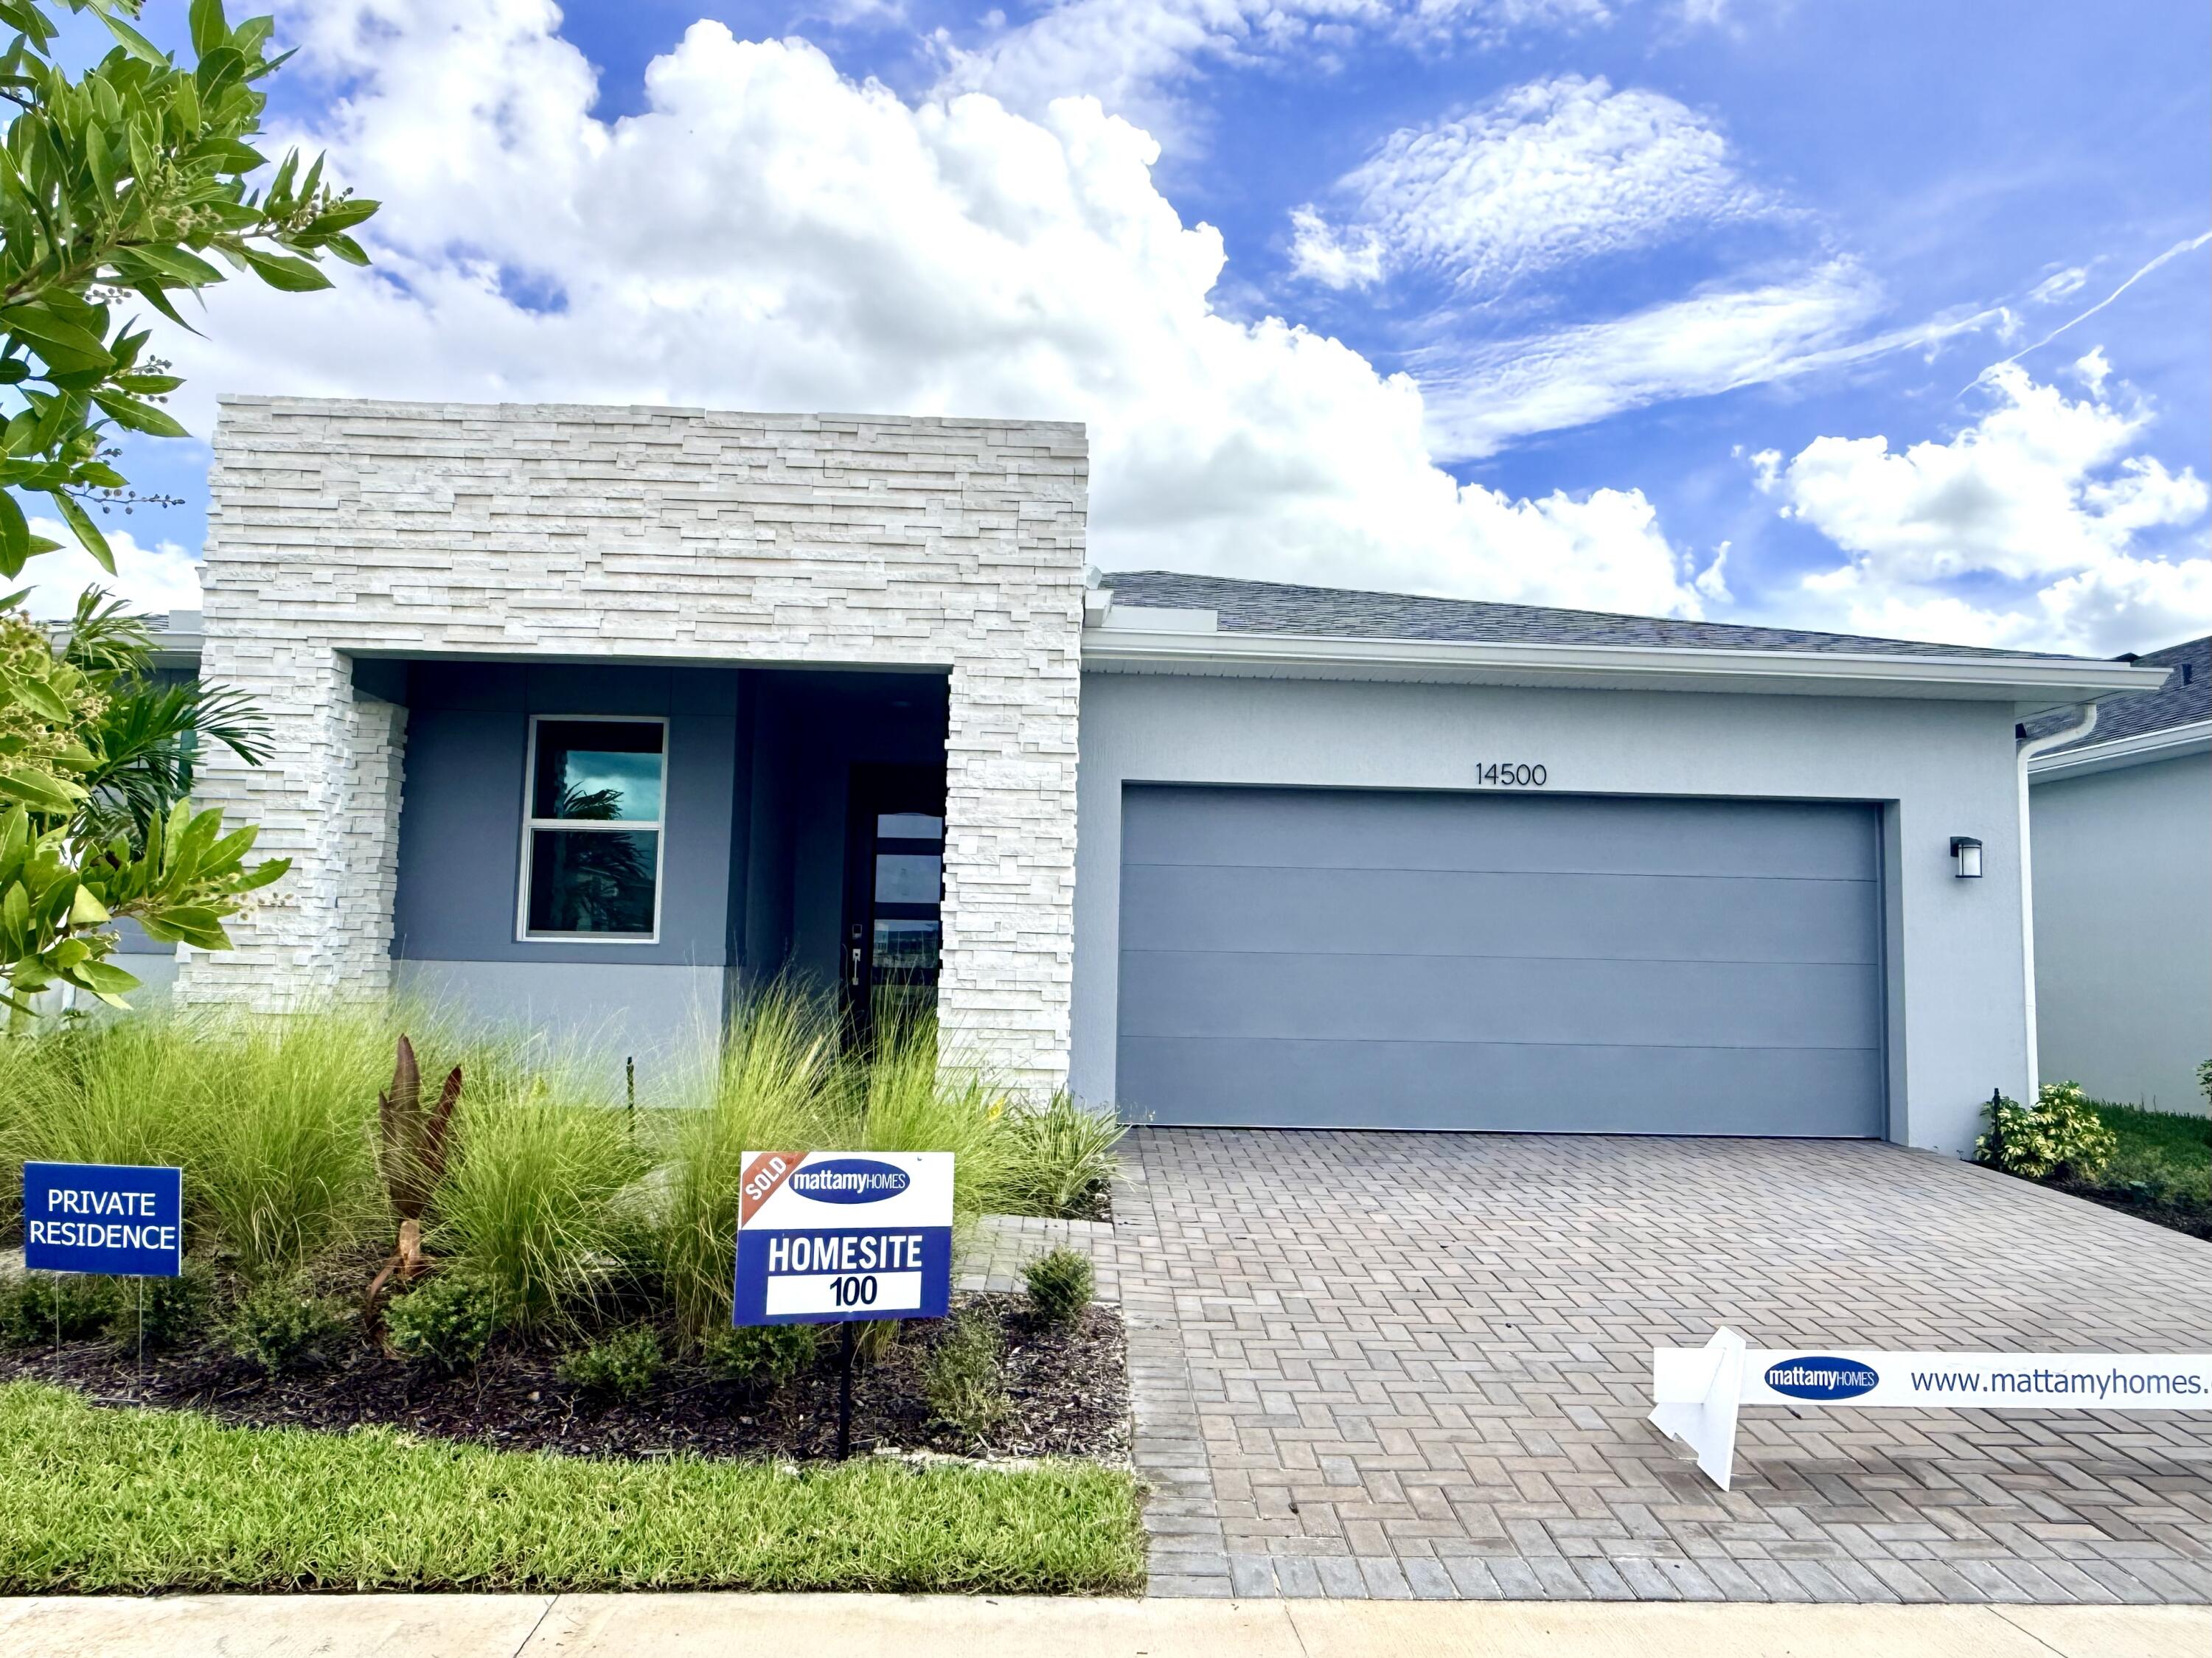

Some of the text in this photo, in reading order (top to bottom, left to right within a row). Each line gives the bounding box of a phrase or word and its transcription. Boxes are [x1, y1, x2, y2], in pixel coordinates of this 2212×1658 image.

[1476, 762, 1547, 785] 14500
[745, 1156, 787, 1200] SOLD
[48, 1188, 156, 1216] PRIVATE
[29, 1220, 176, 1250] RESIDENCE
[768, 1235, 923, 1272] HOMESITE
[830, 1275, 878, 1307] 100
[1910, 1367, 2212, 1400] www.mattamyhomes.
